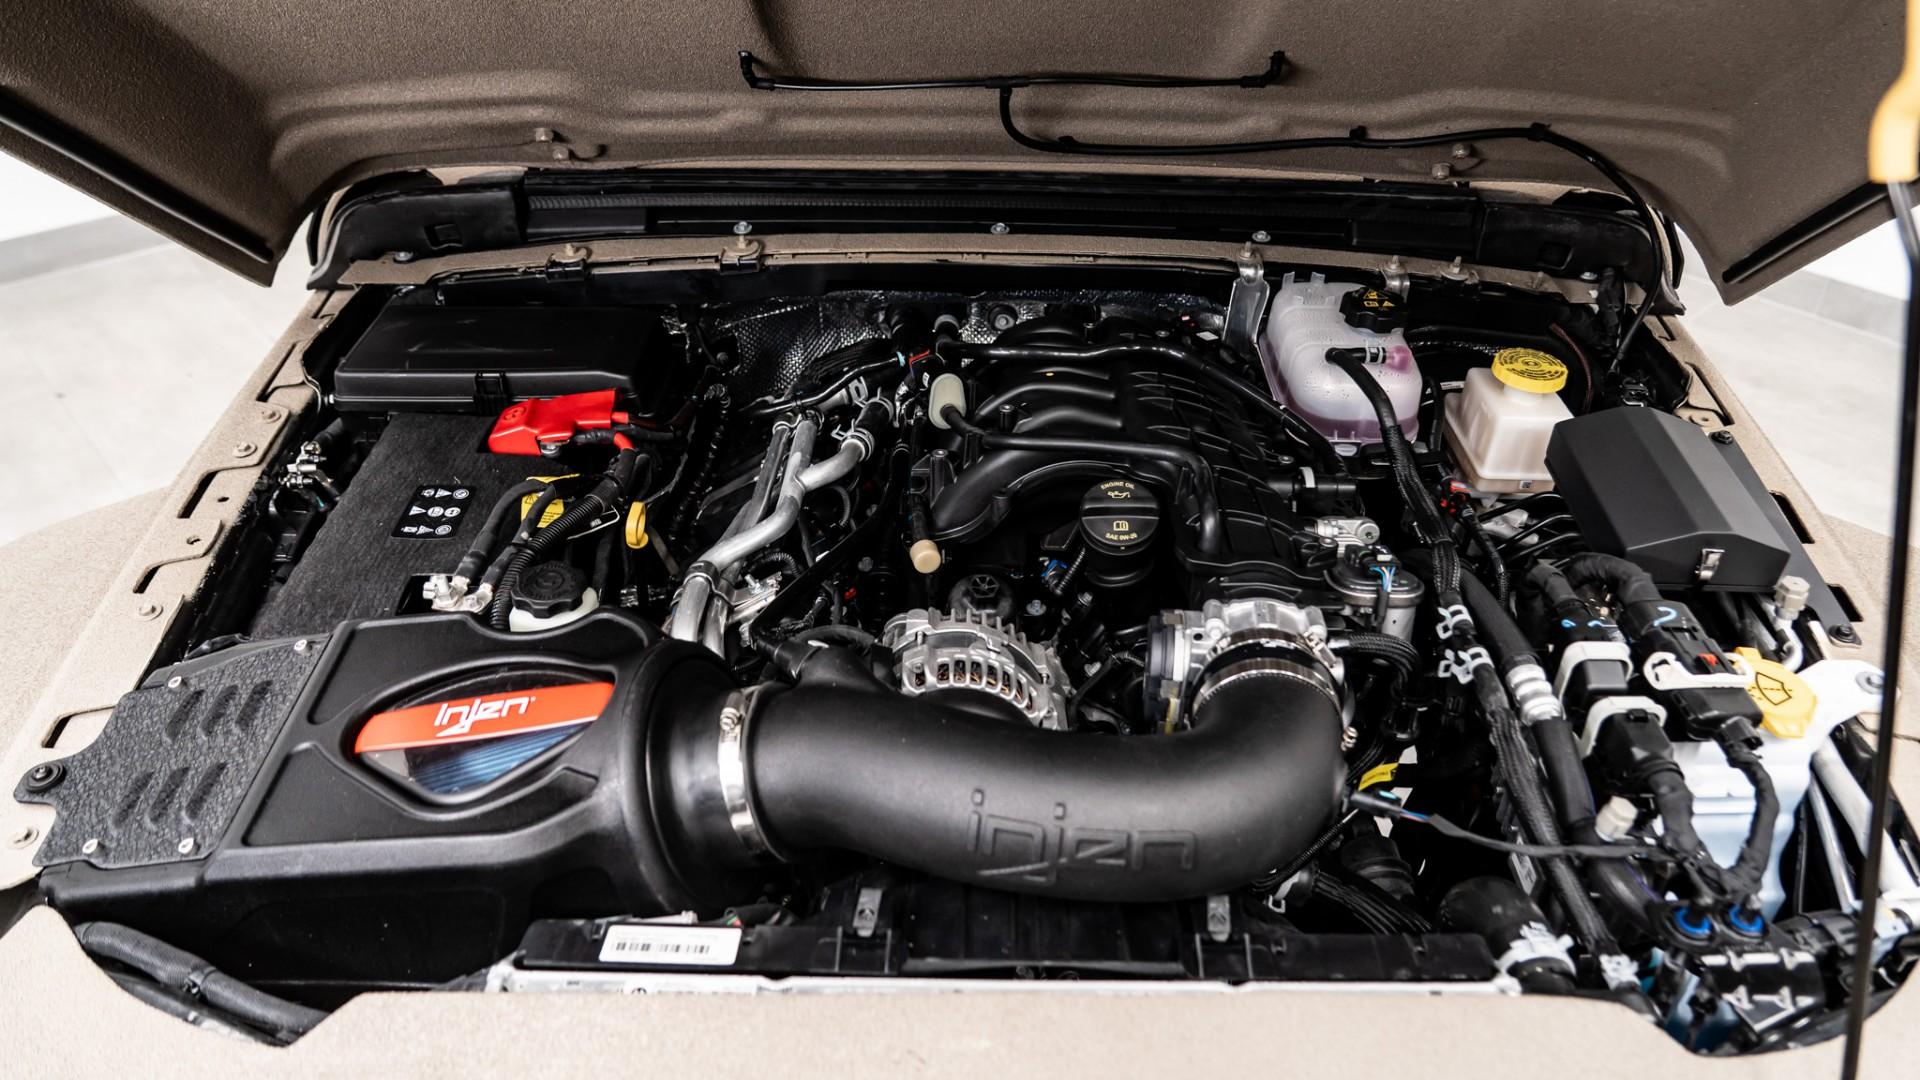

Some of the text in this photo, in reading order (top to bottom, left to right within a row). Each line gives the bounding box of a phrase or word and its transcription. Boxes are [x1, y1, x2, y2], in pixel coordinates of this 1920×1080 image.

[1100, 481, 1135, 490] ENGINE OIL
[1105, 532, 1118, 540] SAE
